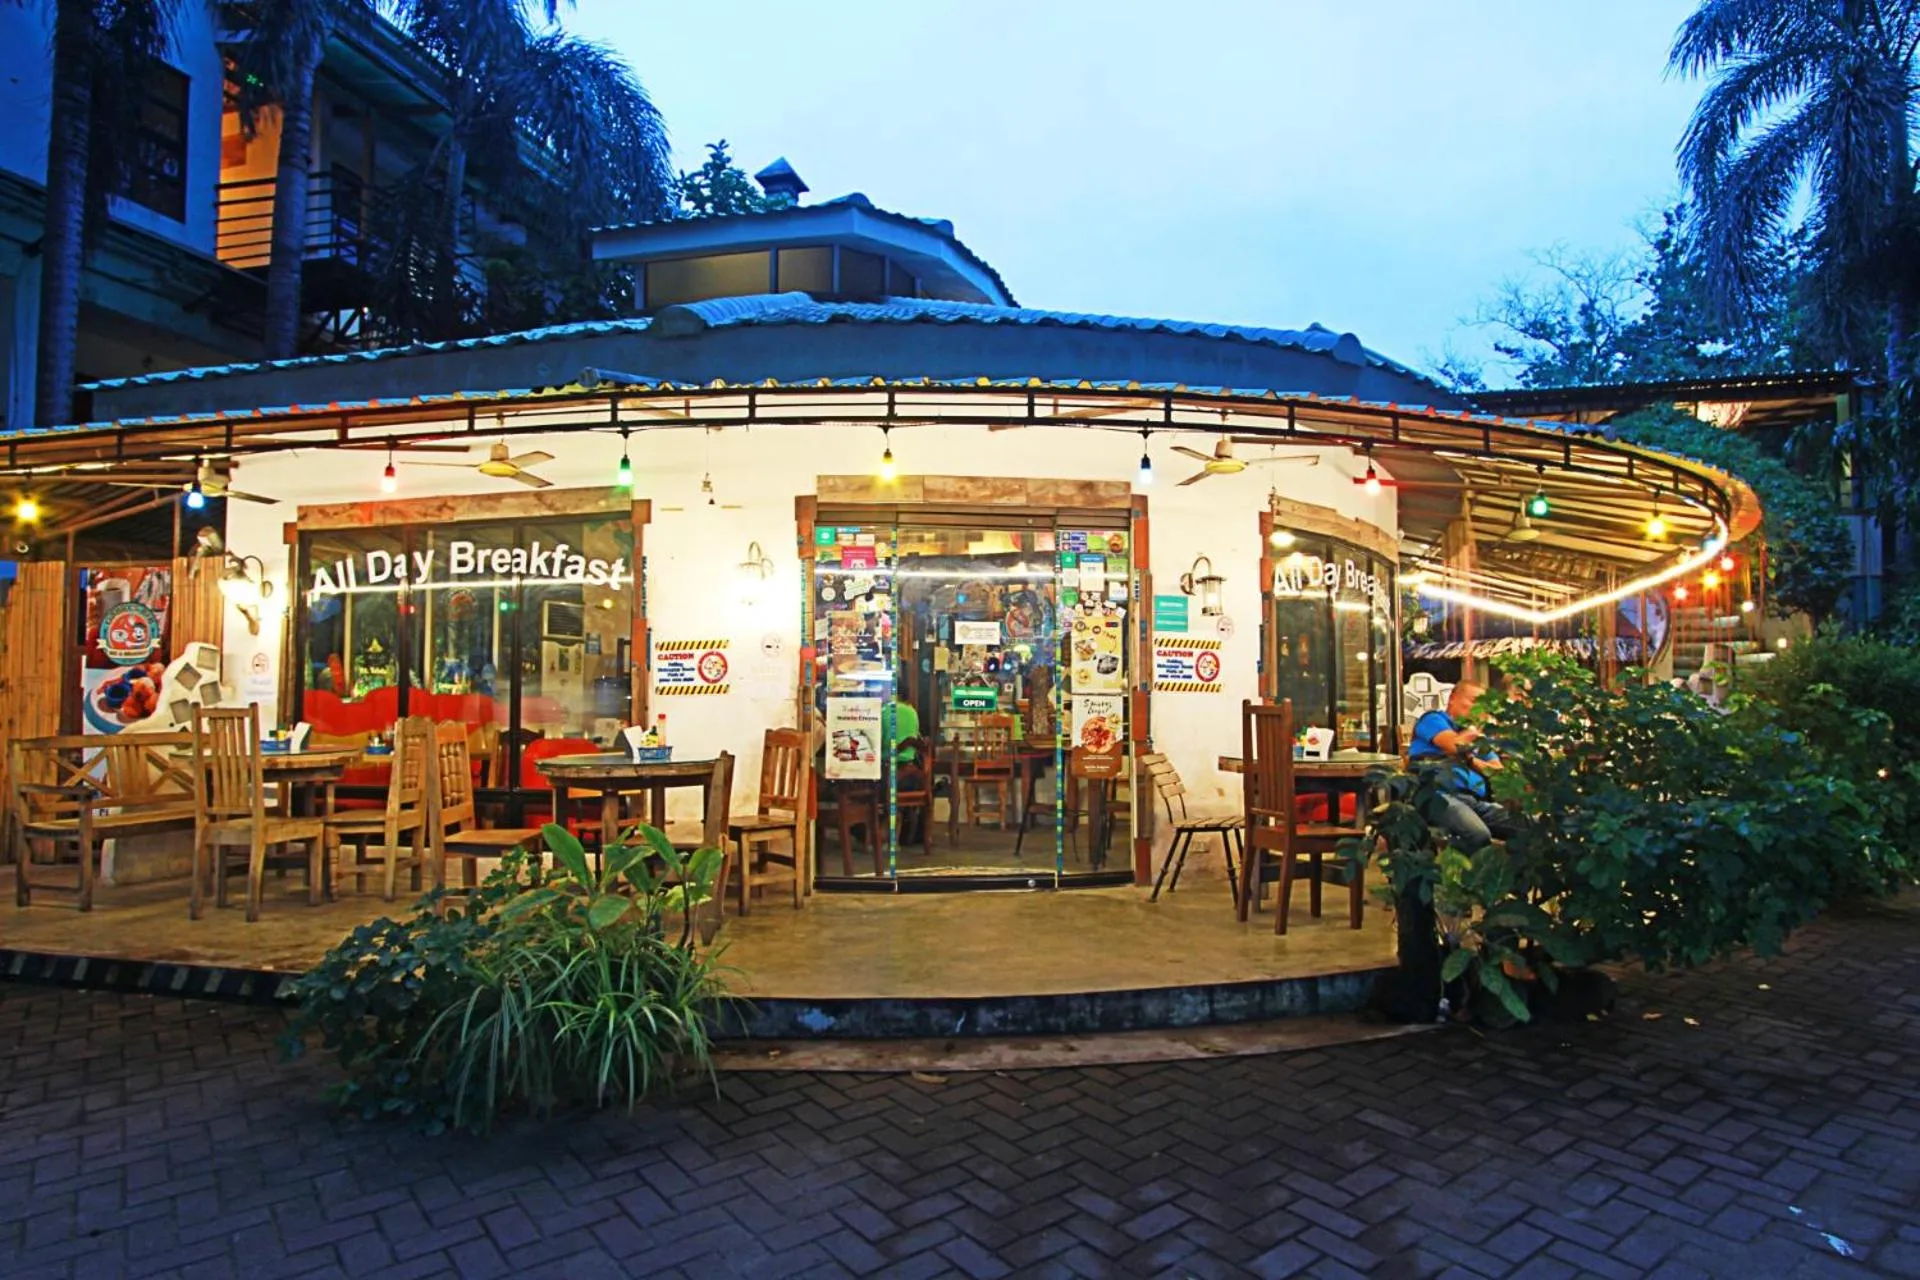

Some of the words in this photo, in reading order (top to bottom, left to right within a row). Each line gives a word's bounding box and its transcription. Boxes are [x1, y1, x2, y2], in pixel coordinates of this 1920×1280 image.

[313, 557, 356, 602] All
[366, 550, 435, 584] Day
[451, 541, 625, 591] Breakfast
[1275, 562, 1303, 594] All
[1309, 556, 1341, 603] Day
